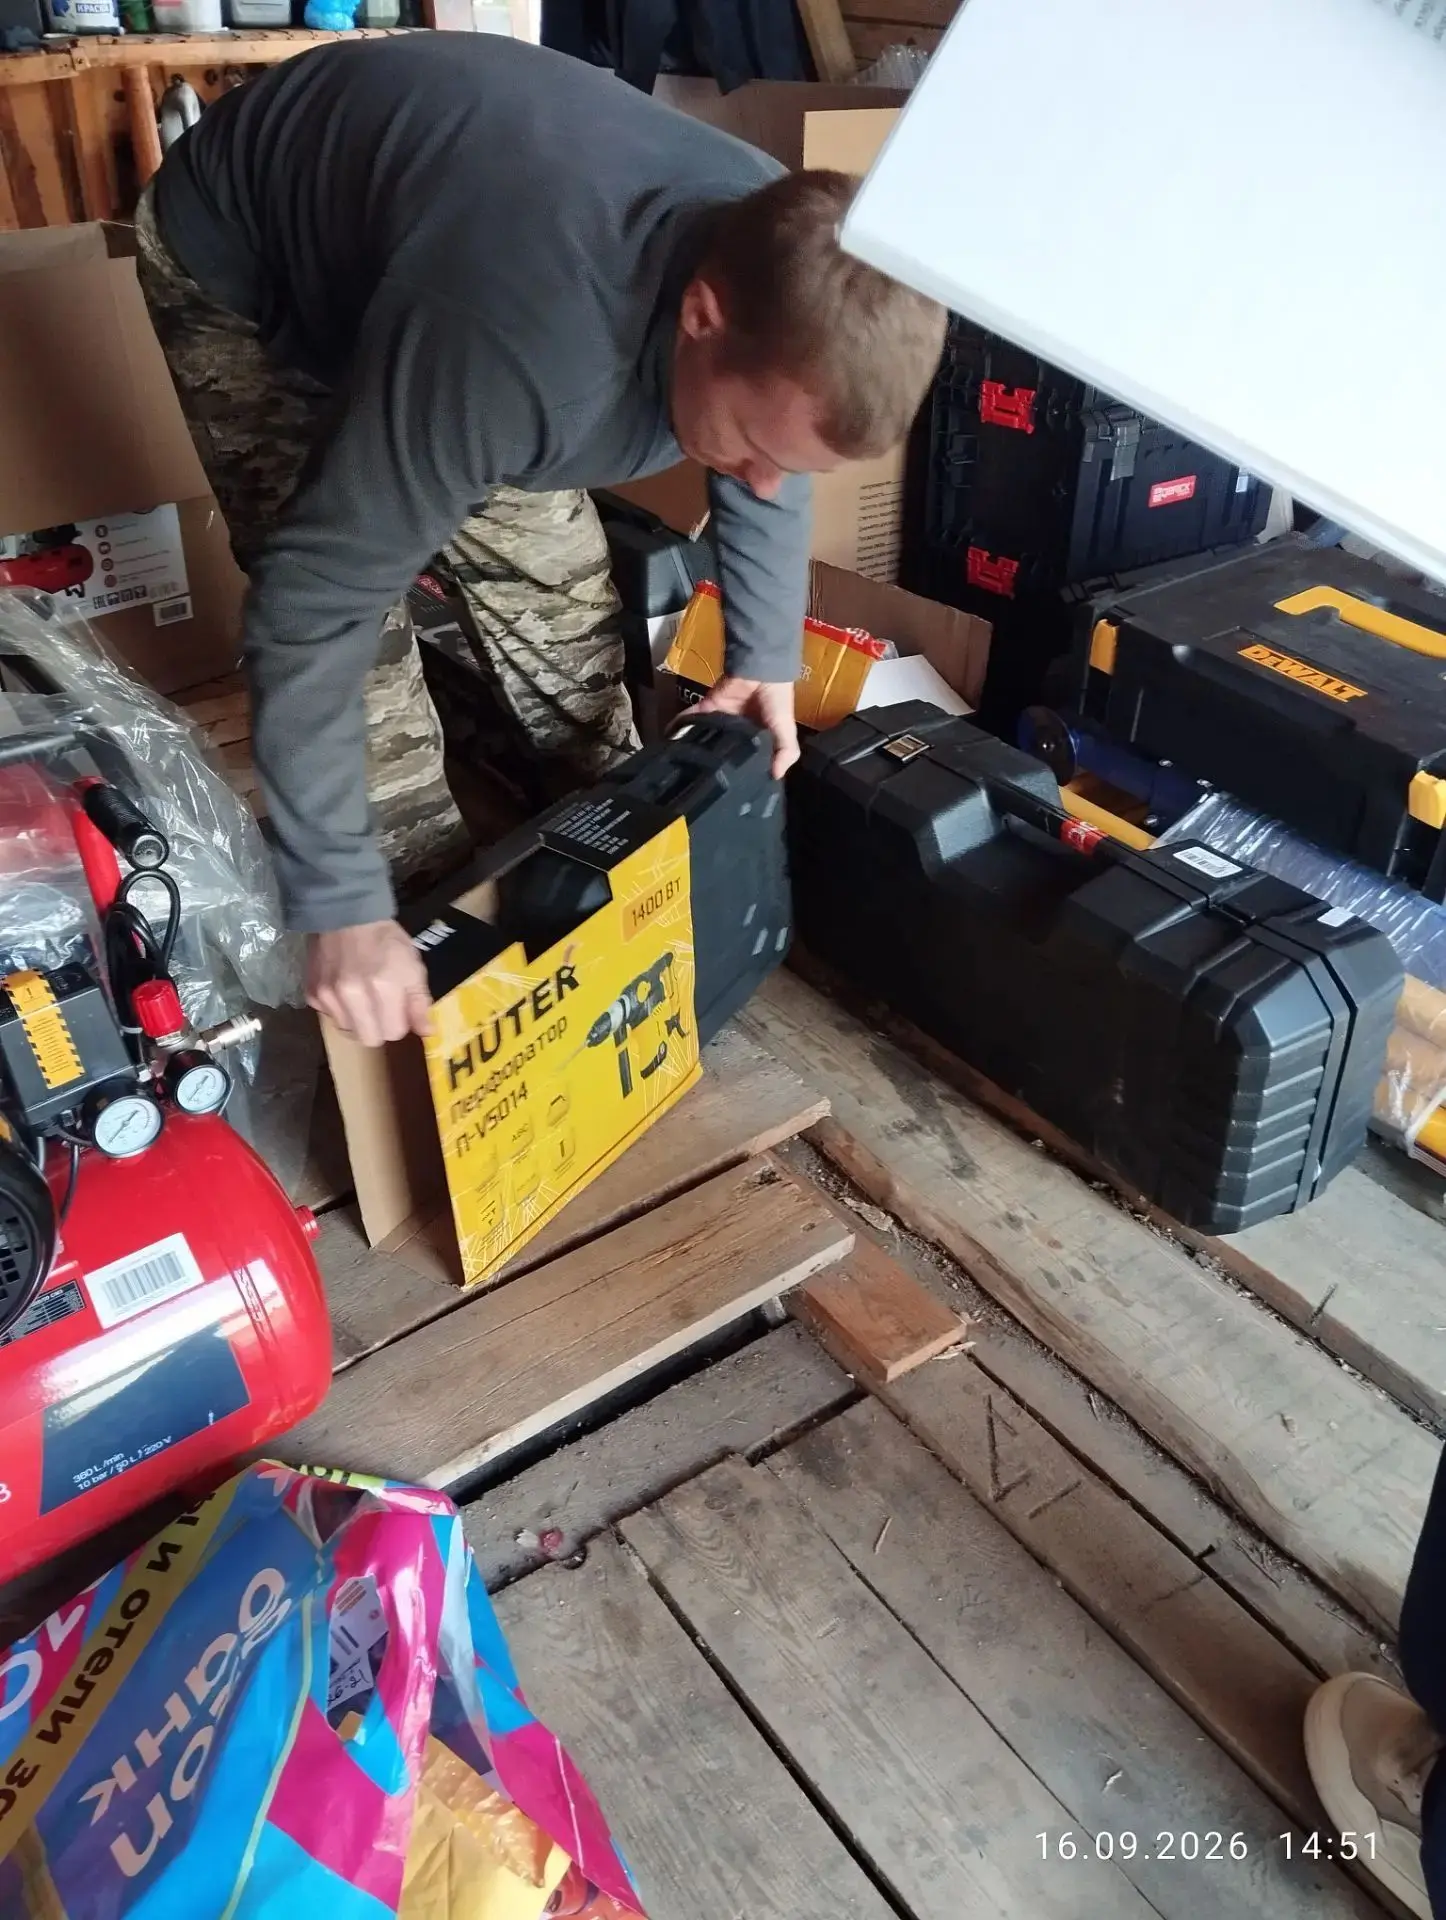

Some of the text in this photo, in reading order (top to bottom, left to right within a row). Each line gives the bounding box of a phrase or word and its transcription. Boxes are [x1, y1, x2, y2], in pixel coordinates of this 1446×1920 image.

[1237, 643, 1368, 703] DEWALT
[631, 876, 681, 927] 1400 Вт
[450, 1015, 568, 1124] Перфоратор
[72, 1468, 94, 1484] 360
[77, 1480, 91, 1491] 10
[92, 1470, 108, 1484] bar
